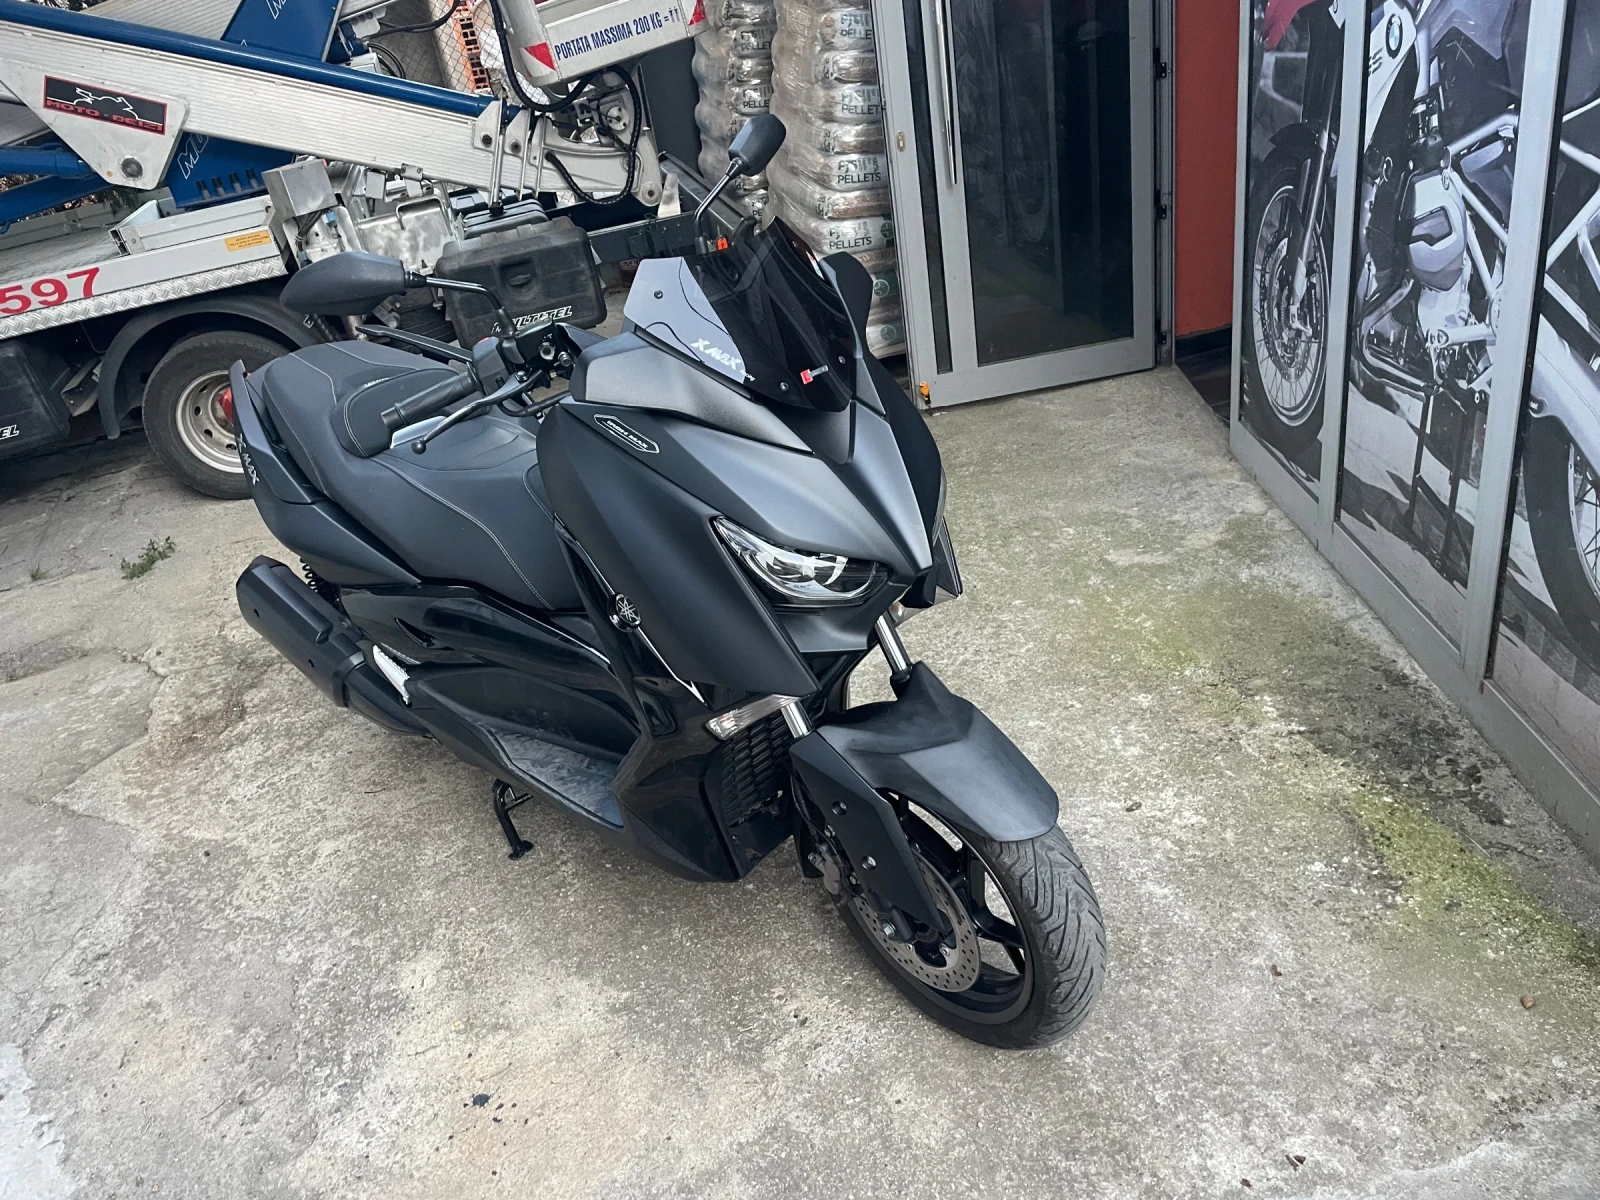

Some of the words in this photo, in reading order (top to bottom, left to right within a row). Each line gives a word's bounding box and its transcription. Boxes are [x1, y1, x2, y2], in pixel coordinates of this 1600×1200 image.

[554, 35, 592, 60] PORTATA
[591, 22, 633, 49] MASSIMA
[633, 19, 651, 35] 200
[650, 11, 663, 29] KG
[46, 99, 100, 117] MOTO
[837, 172, 881, 184] PELLETS
[829, 236, 872, 250] PELLETS
[0, 266, 100, 315] 597
[606, 420, 629, 436] IRON
[628, 434, 649, 449] MAX
